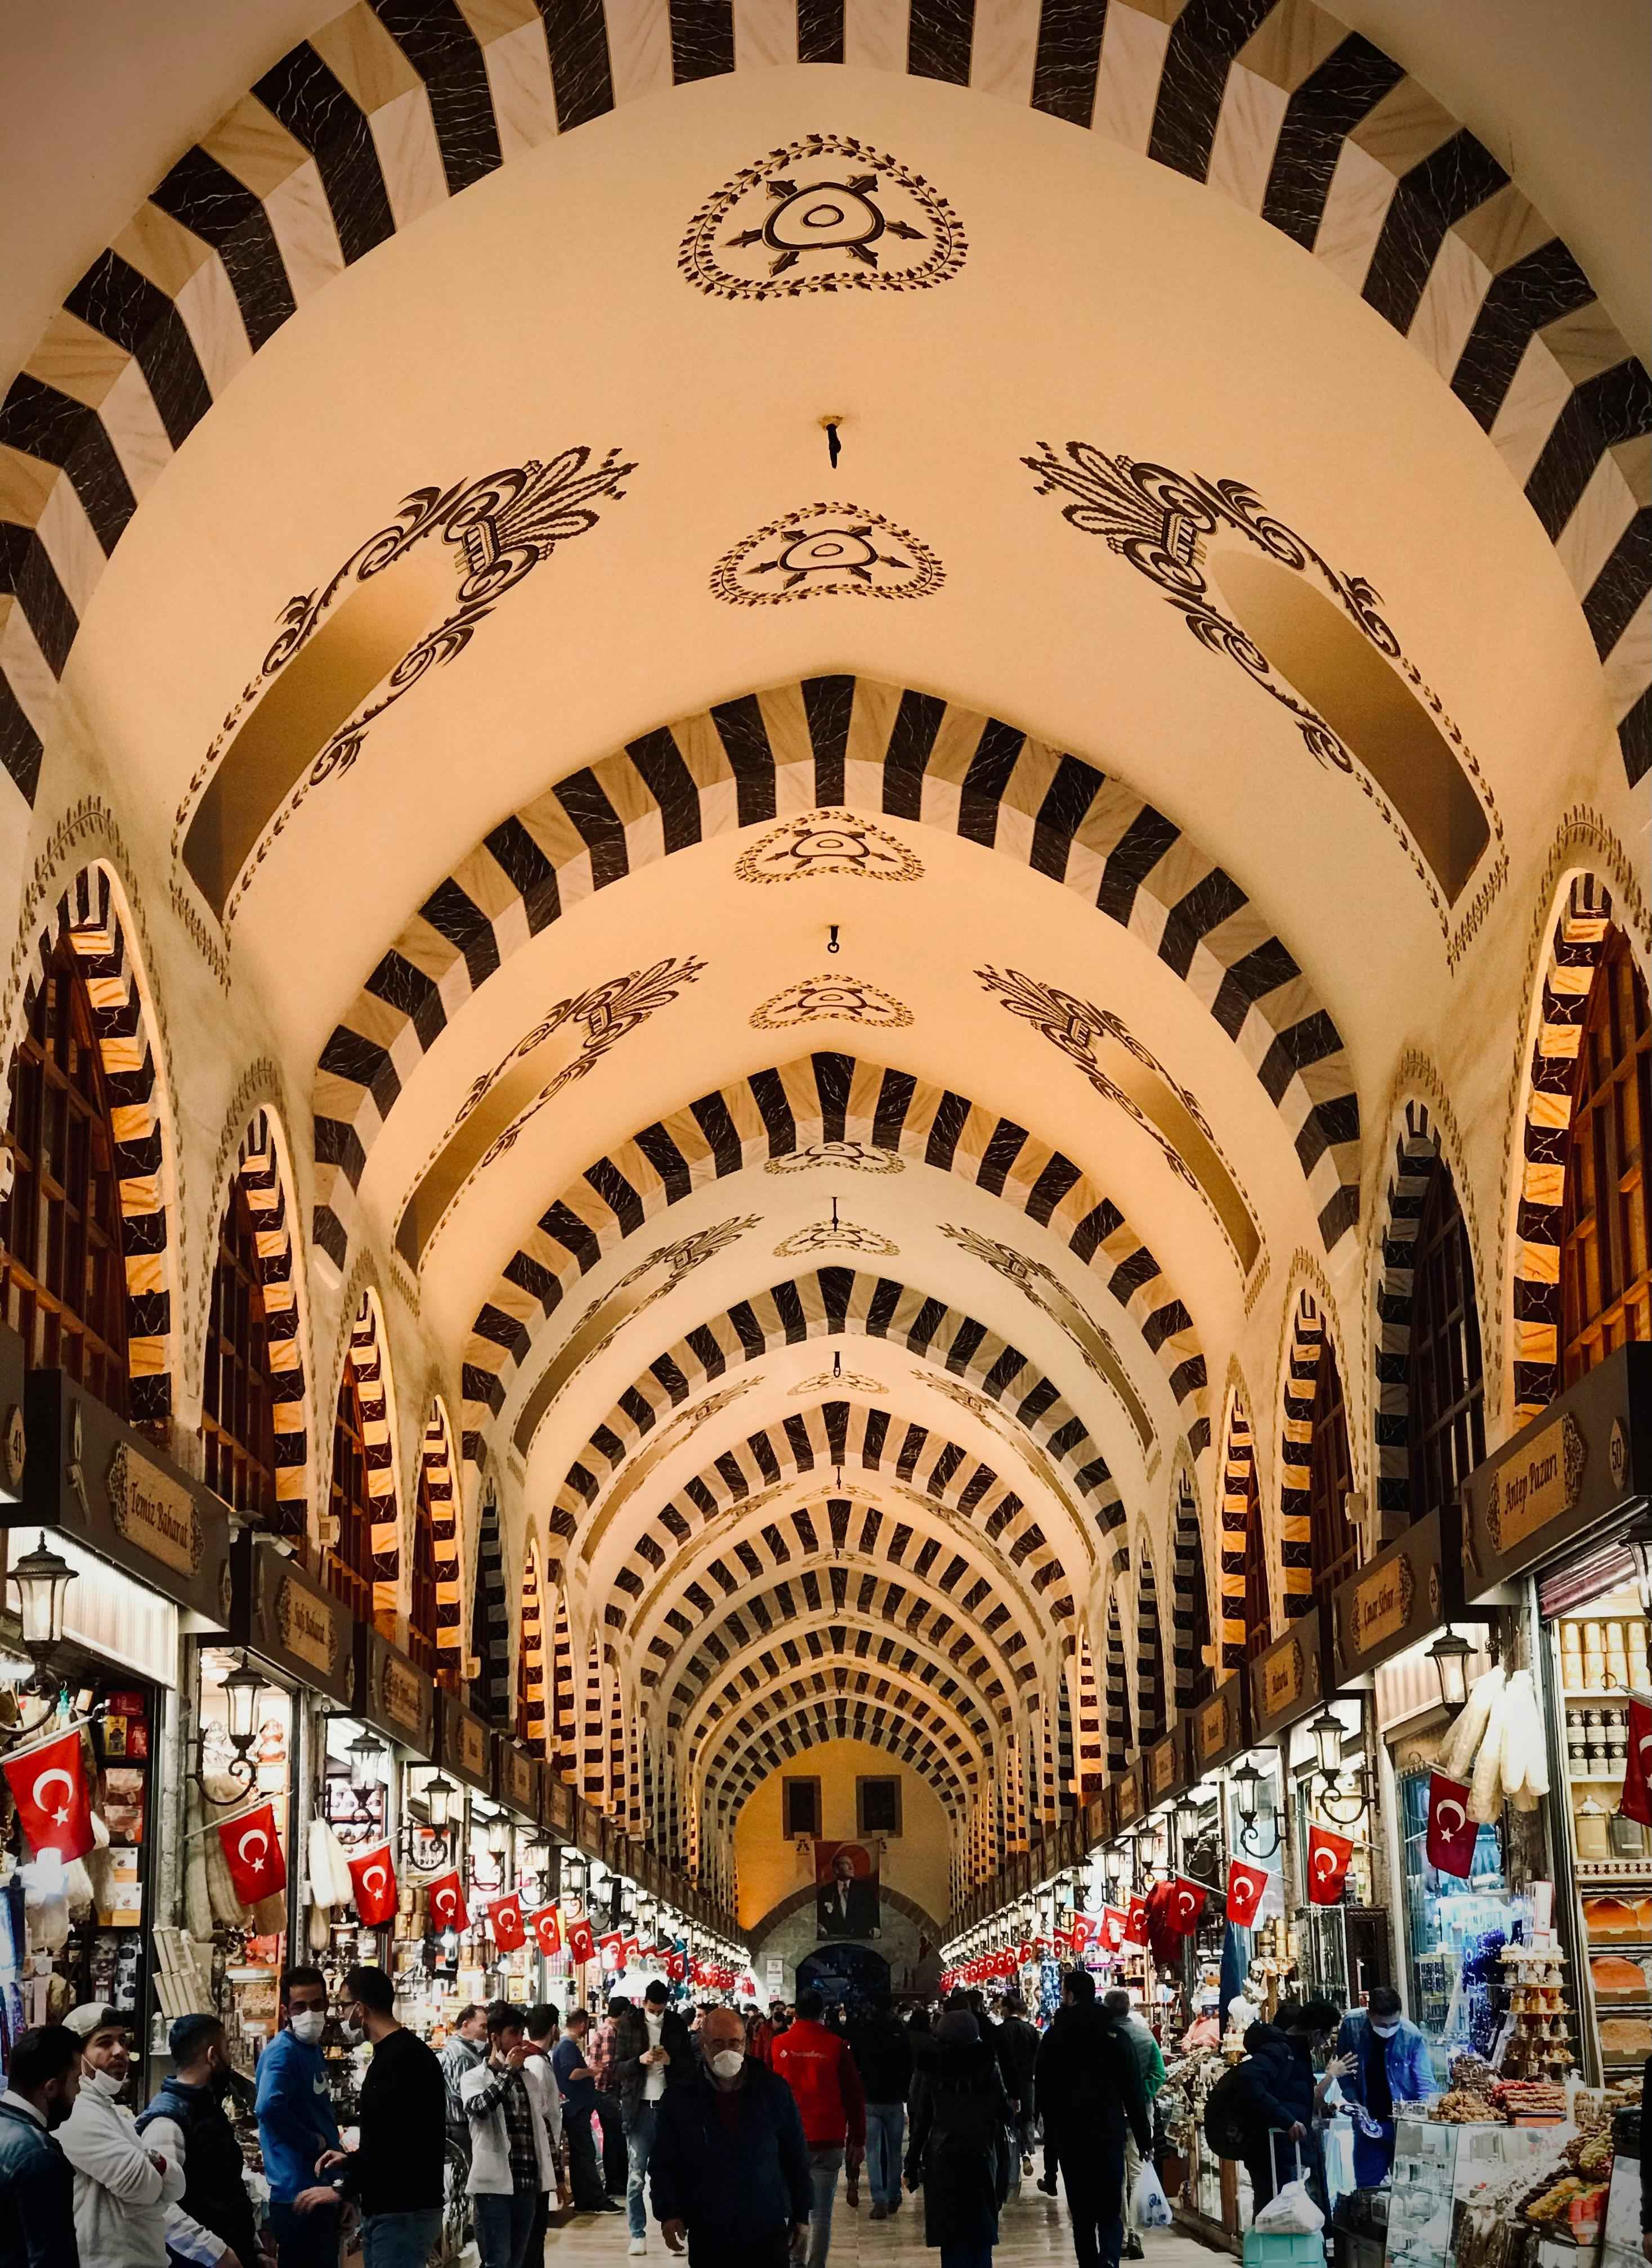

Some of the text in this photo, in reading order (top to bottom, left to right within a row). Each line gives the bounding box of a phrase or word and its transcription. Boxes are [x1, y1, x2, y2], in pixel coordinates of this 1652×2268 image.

[13, 1429, 21, 1463] 41
[1611, 1438, 1622, 1470] 50
[1505, 1476, 1527, 1514] Antep
[130, 1481, 188, 1549] Temiz Baharat
